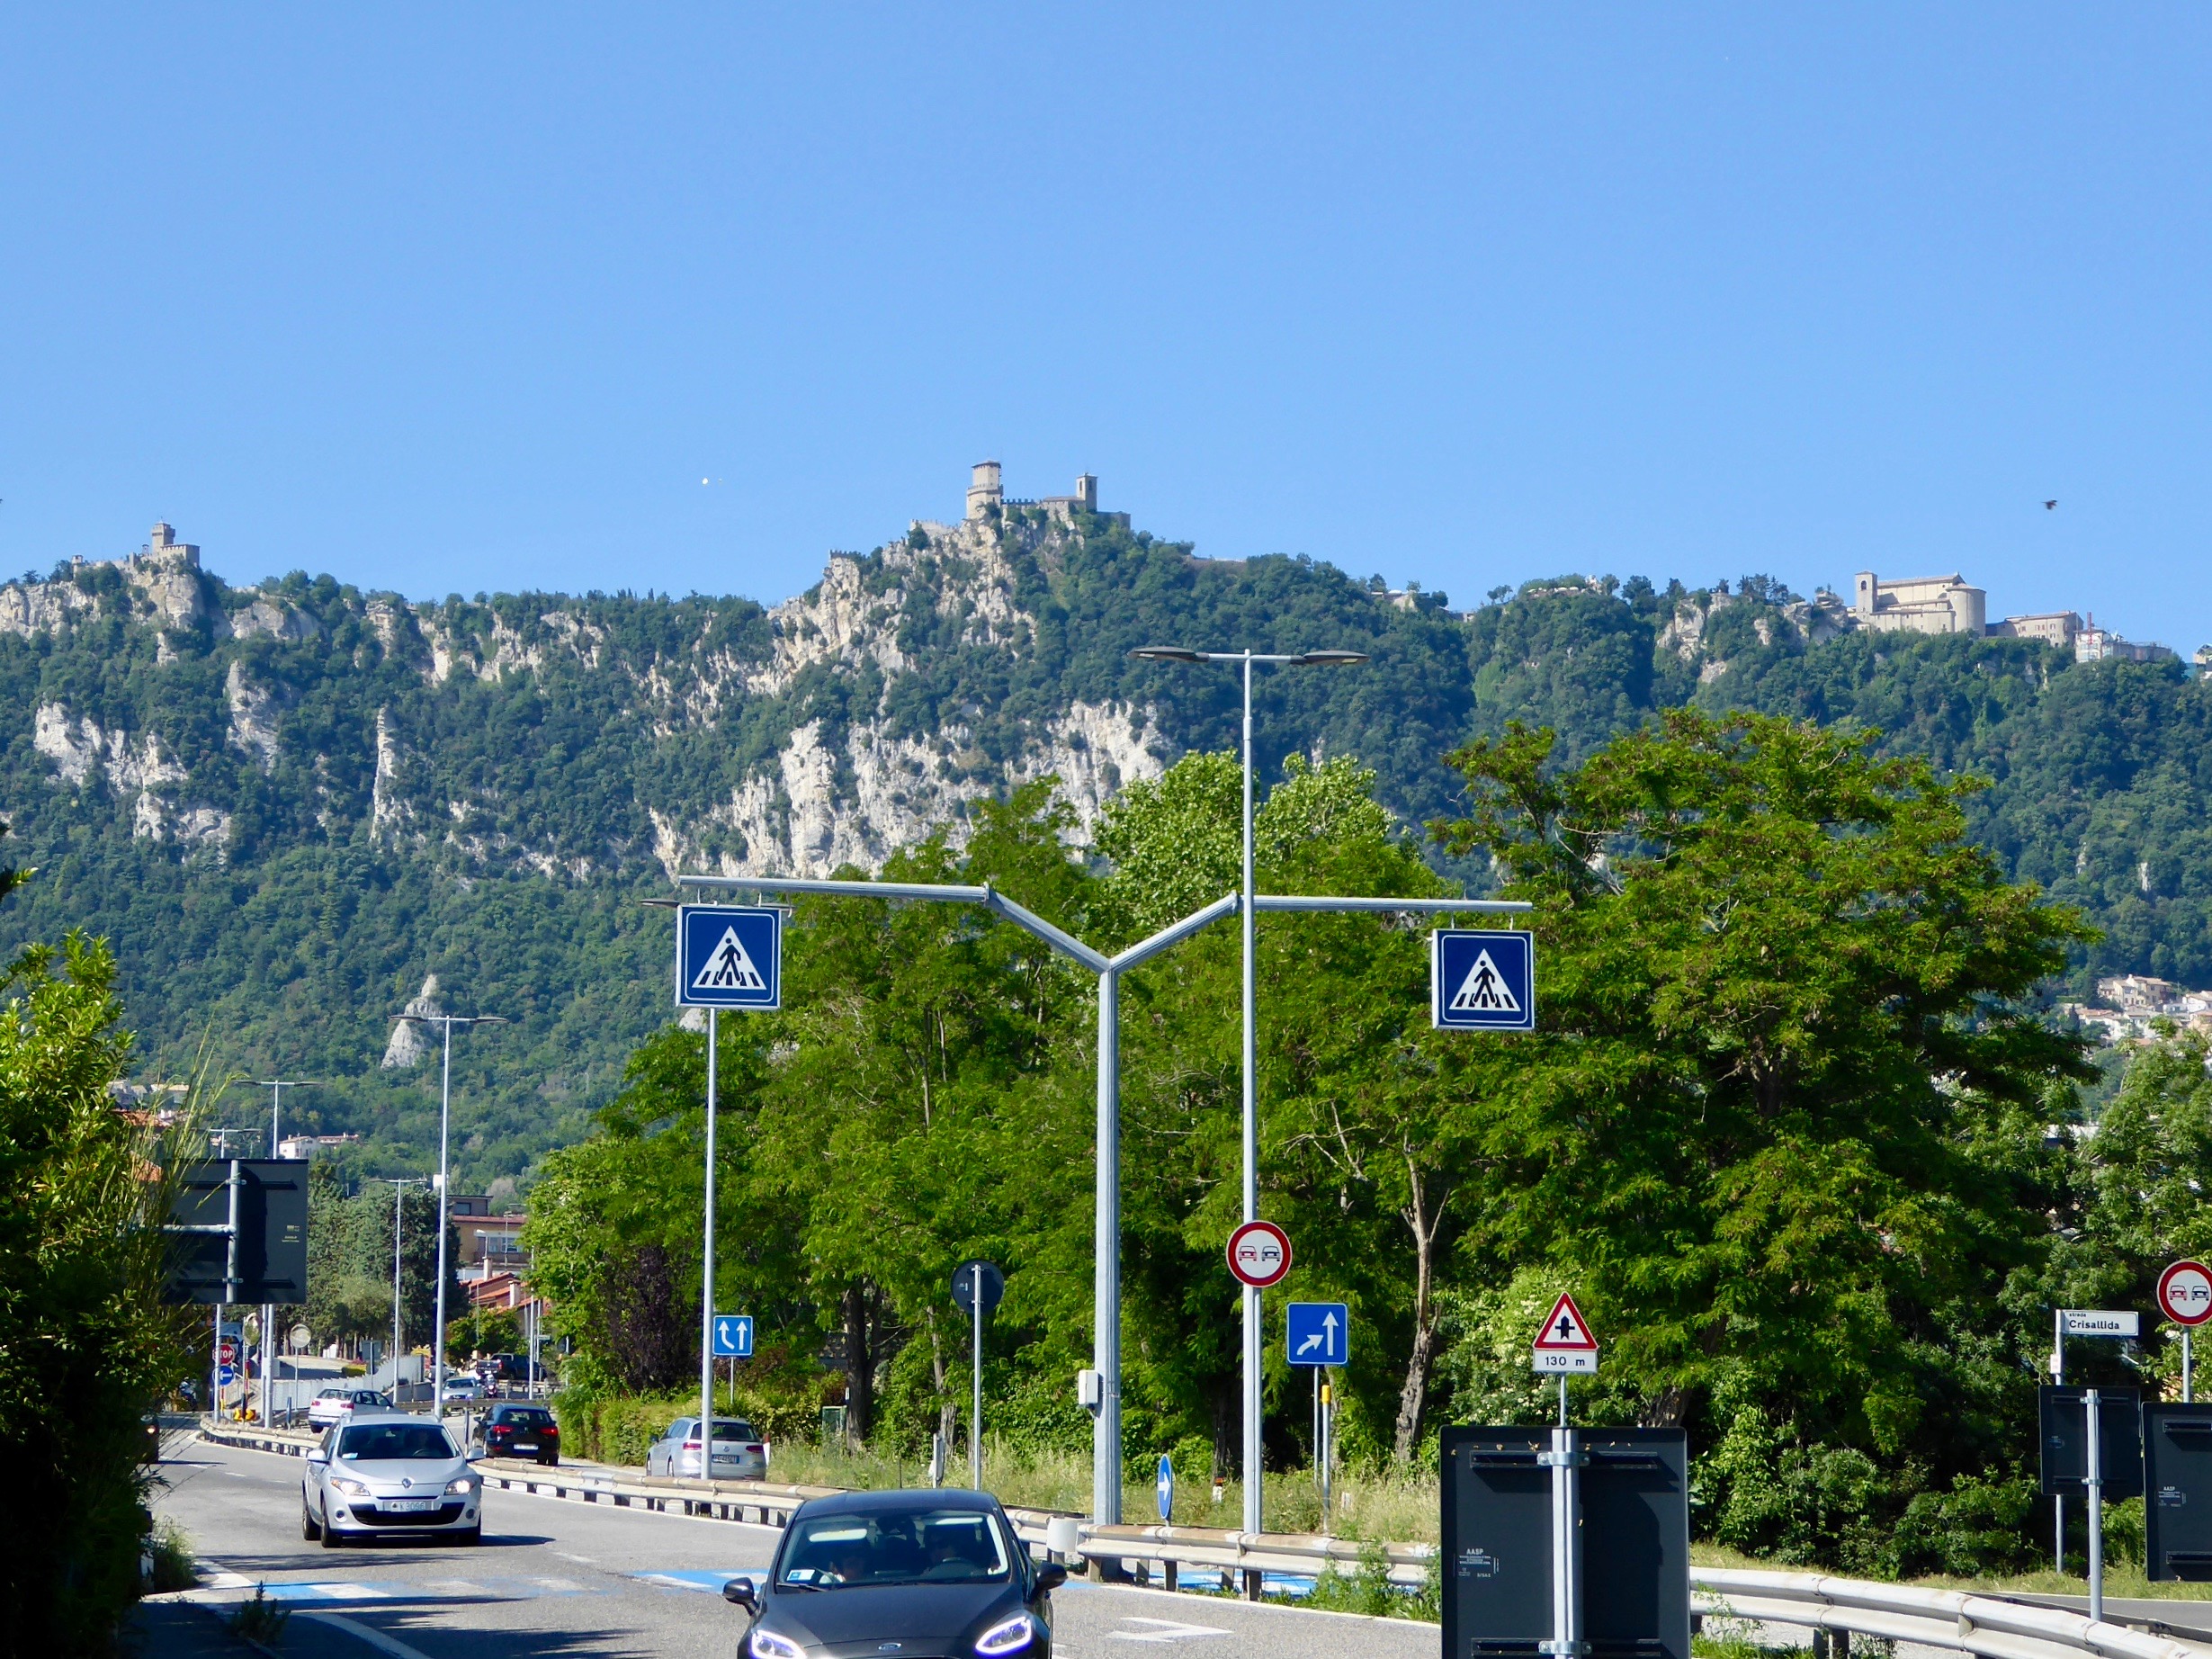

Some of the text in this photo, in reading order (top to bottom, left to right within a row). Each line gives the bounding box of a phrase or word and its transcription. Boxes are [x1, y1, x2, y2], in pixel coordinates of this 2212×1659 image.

[2069, 1320, 2119, 1330] Crisallida
[1545, 1356, 1585, 1367] 130 m
